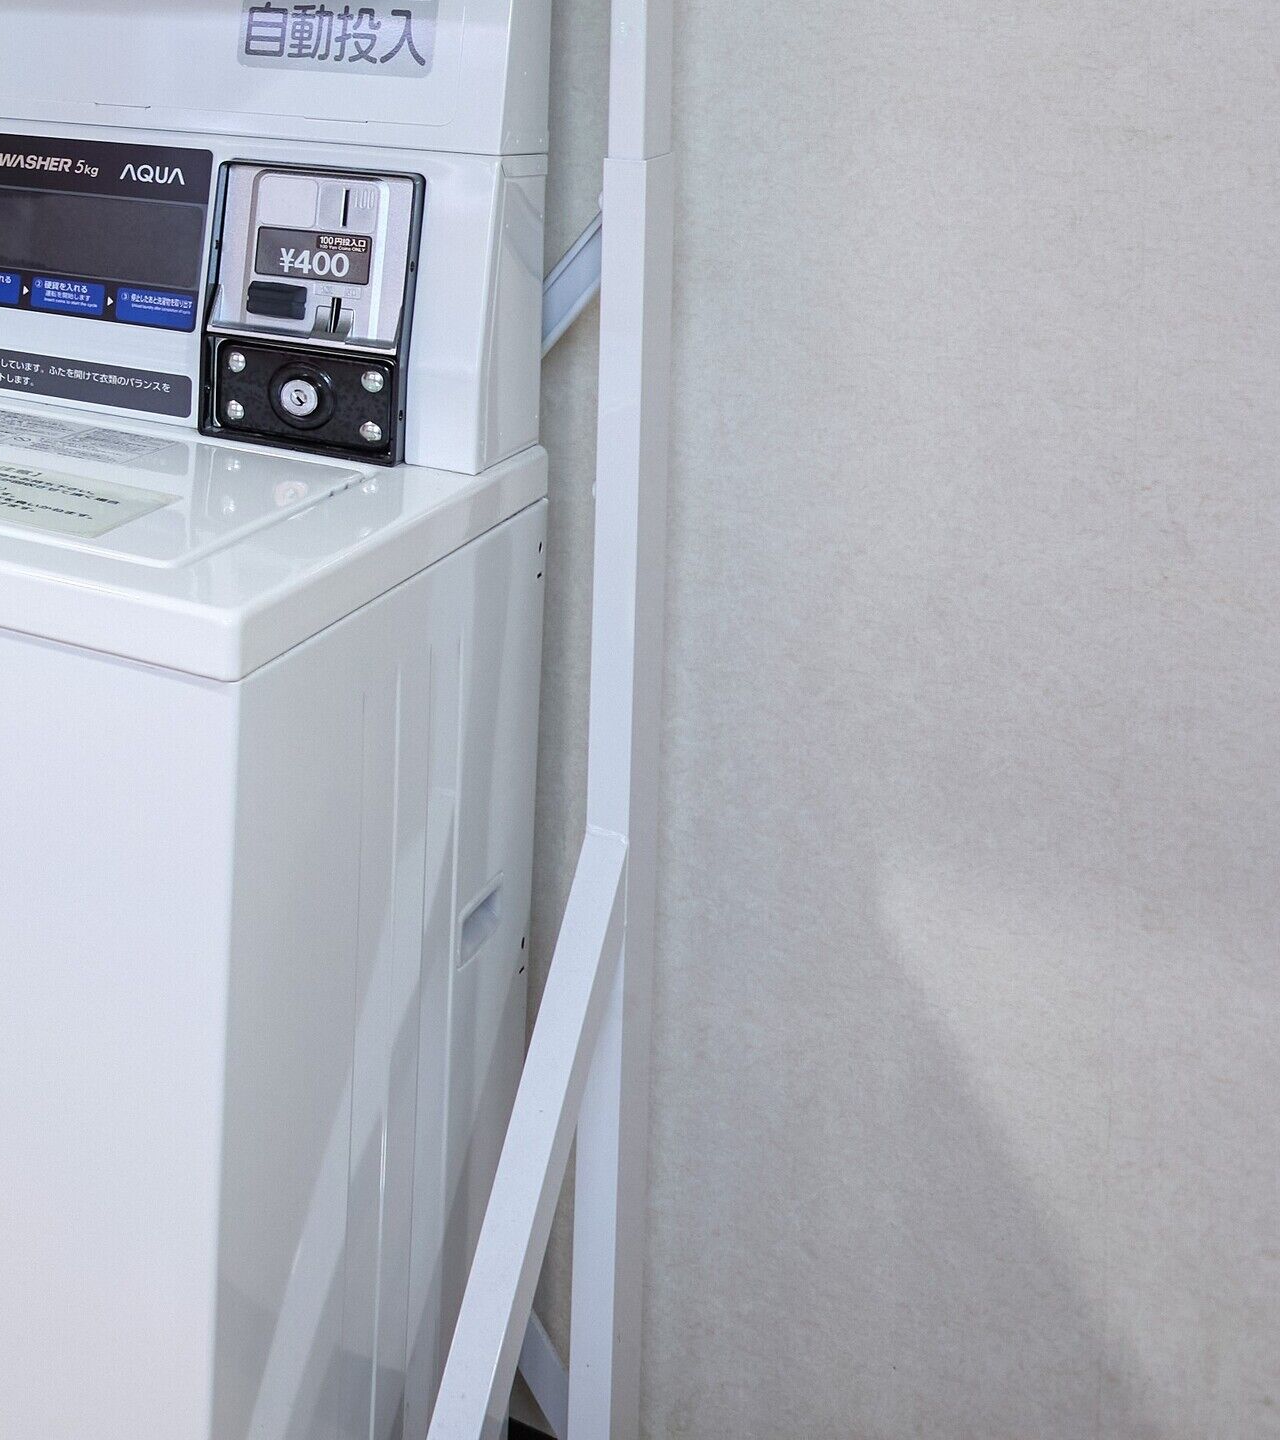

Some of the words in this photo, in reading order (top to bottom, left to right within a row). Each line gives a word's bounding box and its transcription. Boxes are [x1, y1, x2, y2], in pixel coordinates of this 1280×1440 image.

[244, 2, 427, 67] 自動投入
[75, 159, 100, 178] 5kg
[119, 163, 186, 186] AQUA
[320, 236, 366, 248] 100円投入口
[279, 247, 349, 278] ¥400
[44, 280, 88, 294] 硬貨を入れる
[45, 290, 91, 302] 運転を開始します
